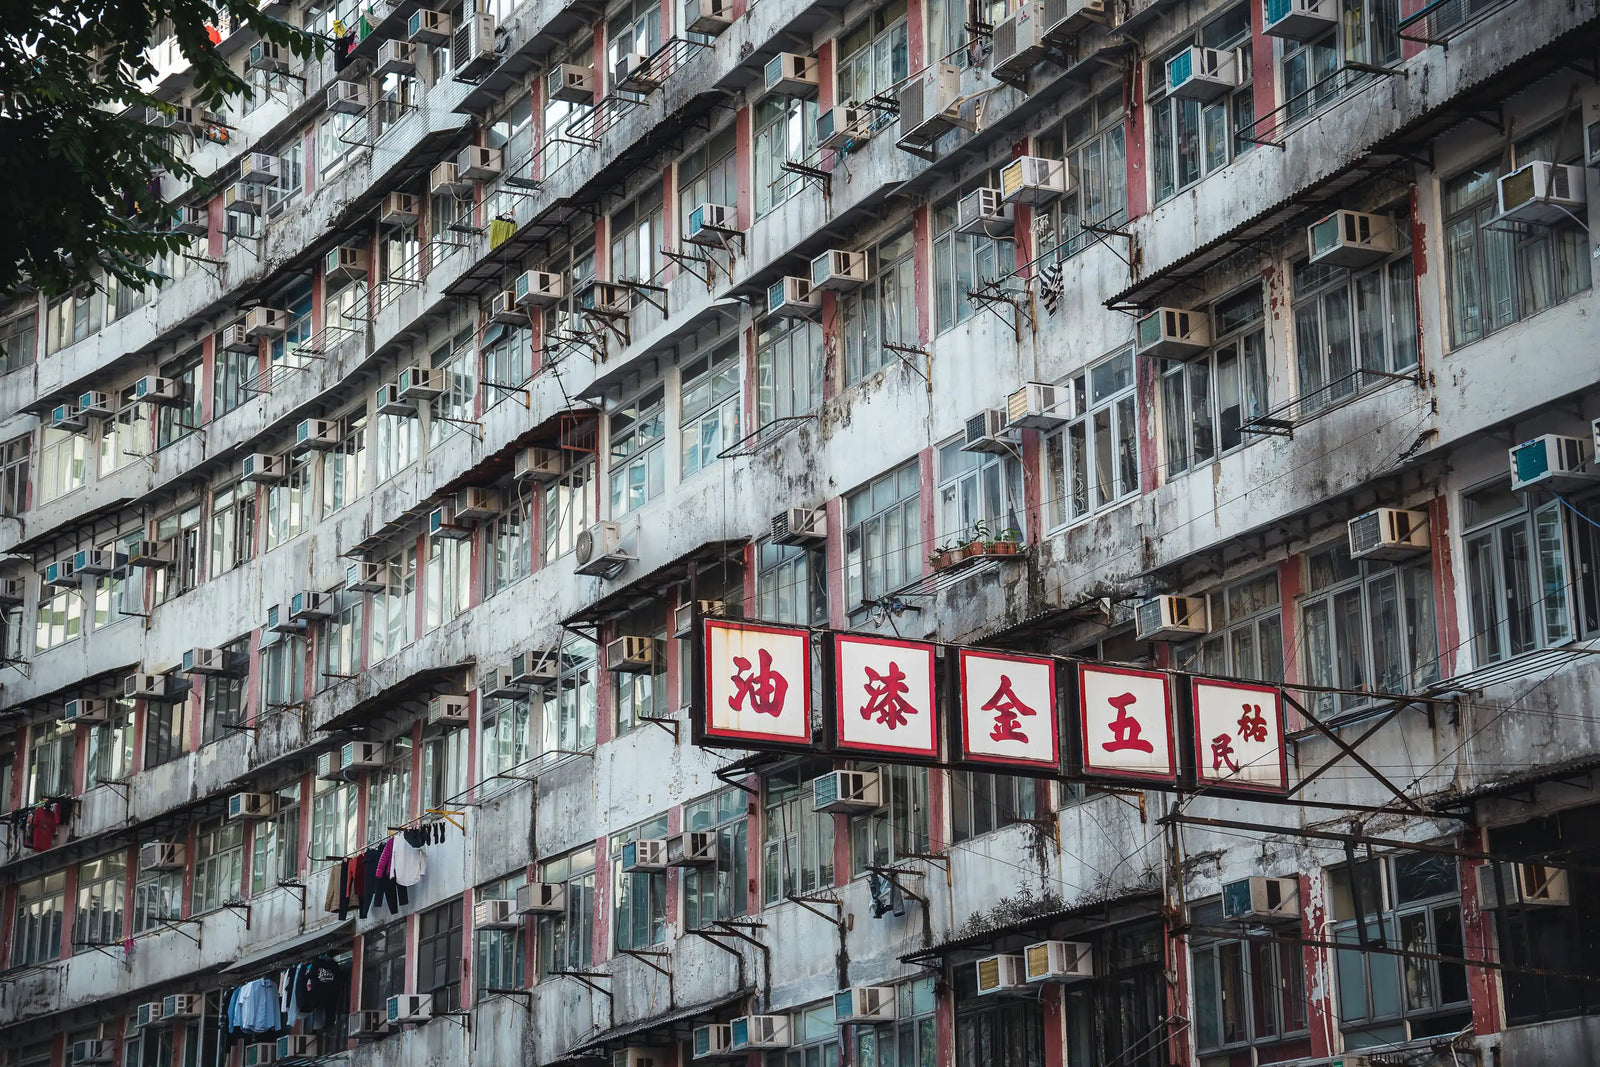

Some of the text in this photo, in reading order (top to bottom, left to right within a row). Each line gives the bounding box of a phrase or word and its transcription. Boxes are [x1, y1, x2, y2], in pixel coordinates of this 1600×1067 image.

[728, 648, 789, 718] 油
[860, 661, 919, 730] 漆
[981, 674, 1037, 744] 金
[1102, 693, 1154, 754] 五
